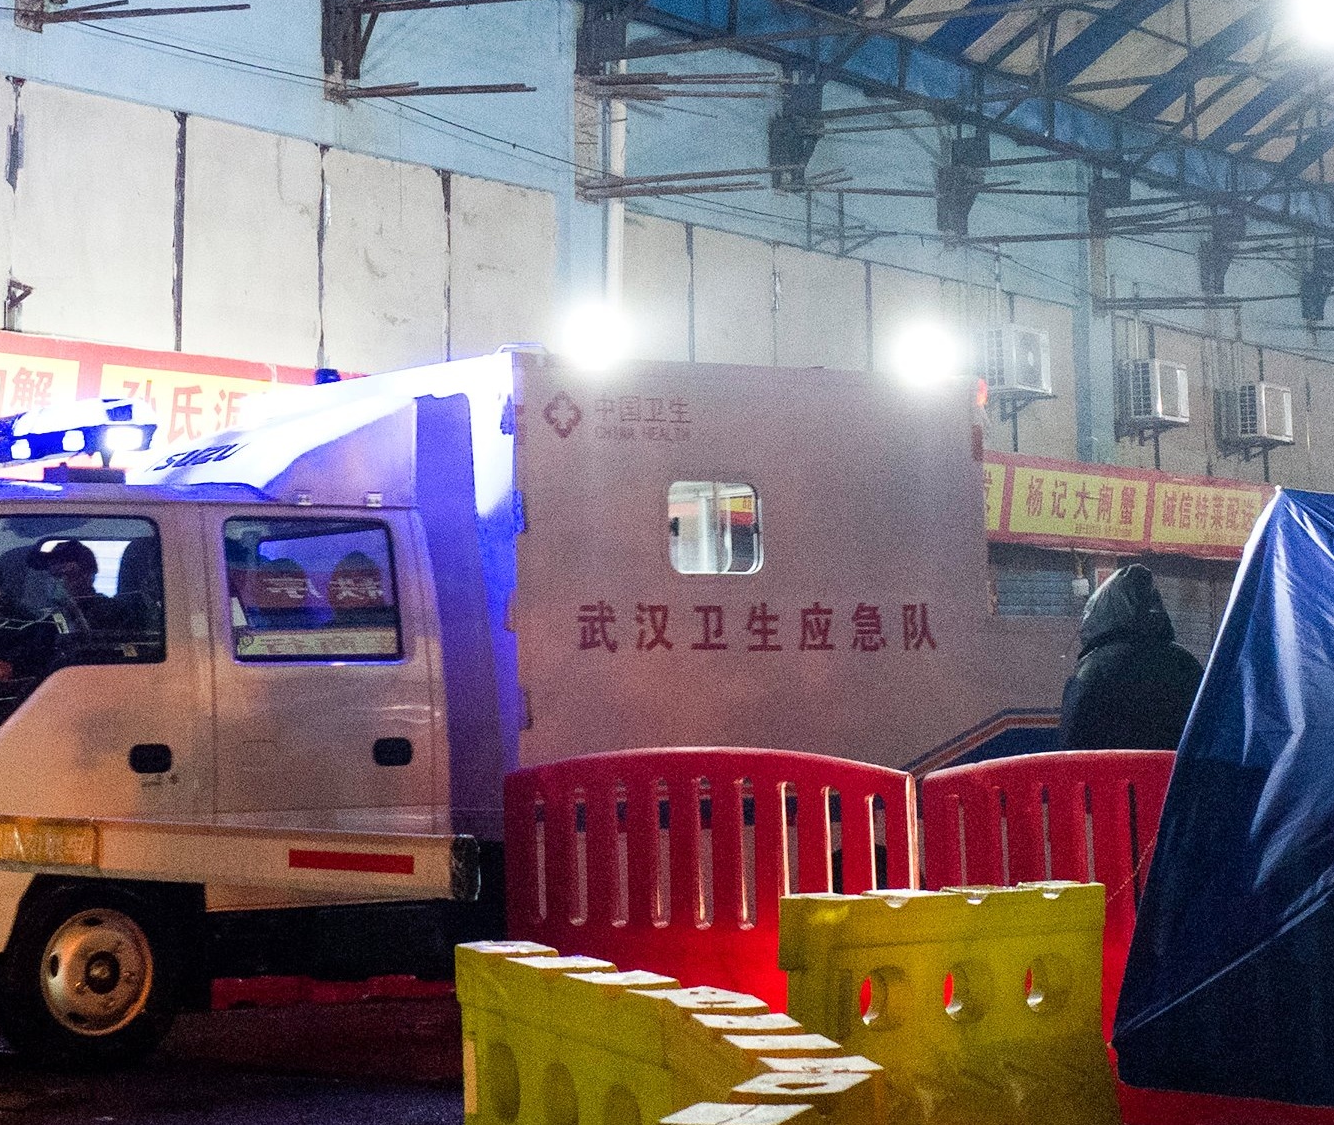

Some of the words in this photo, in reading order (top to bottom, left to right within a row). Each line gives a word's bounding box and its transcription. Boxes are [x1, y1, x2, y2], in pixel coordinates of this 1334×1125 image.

[594, 393, 692, 424] 中国卫生
[144, 442, 250, 473] SUZU
[577, 600, 938, 653] 武汉卫生应急队
